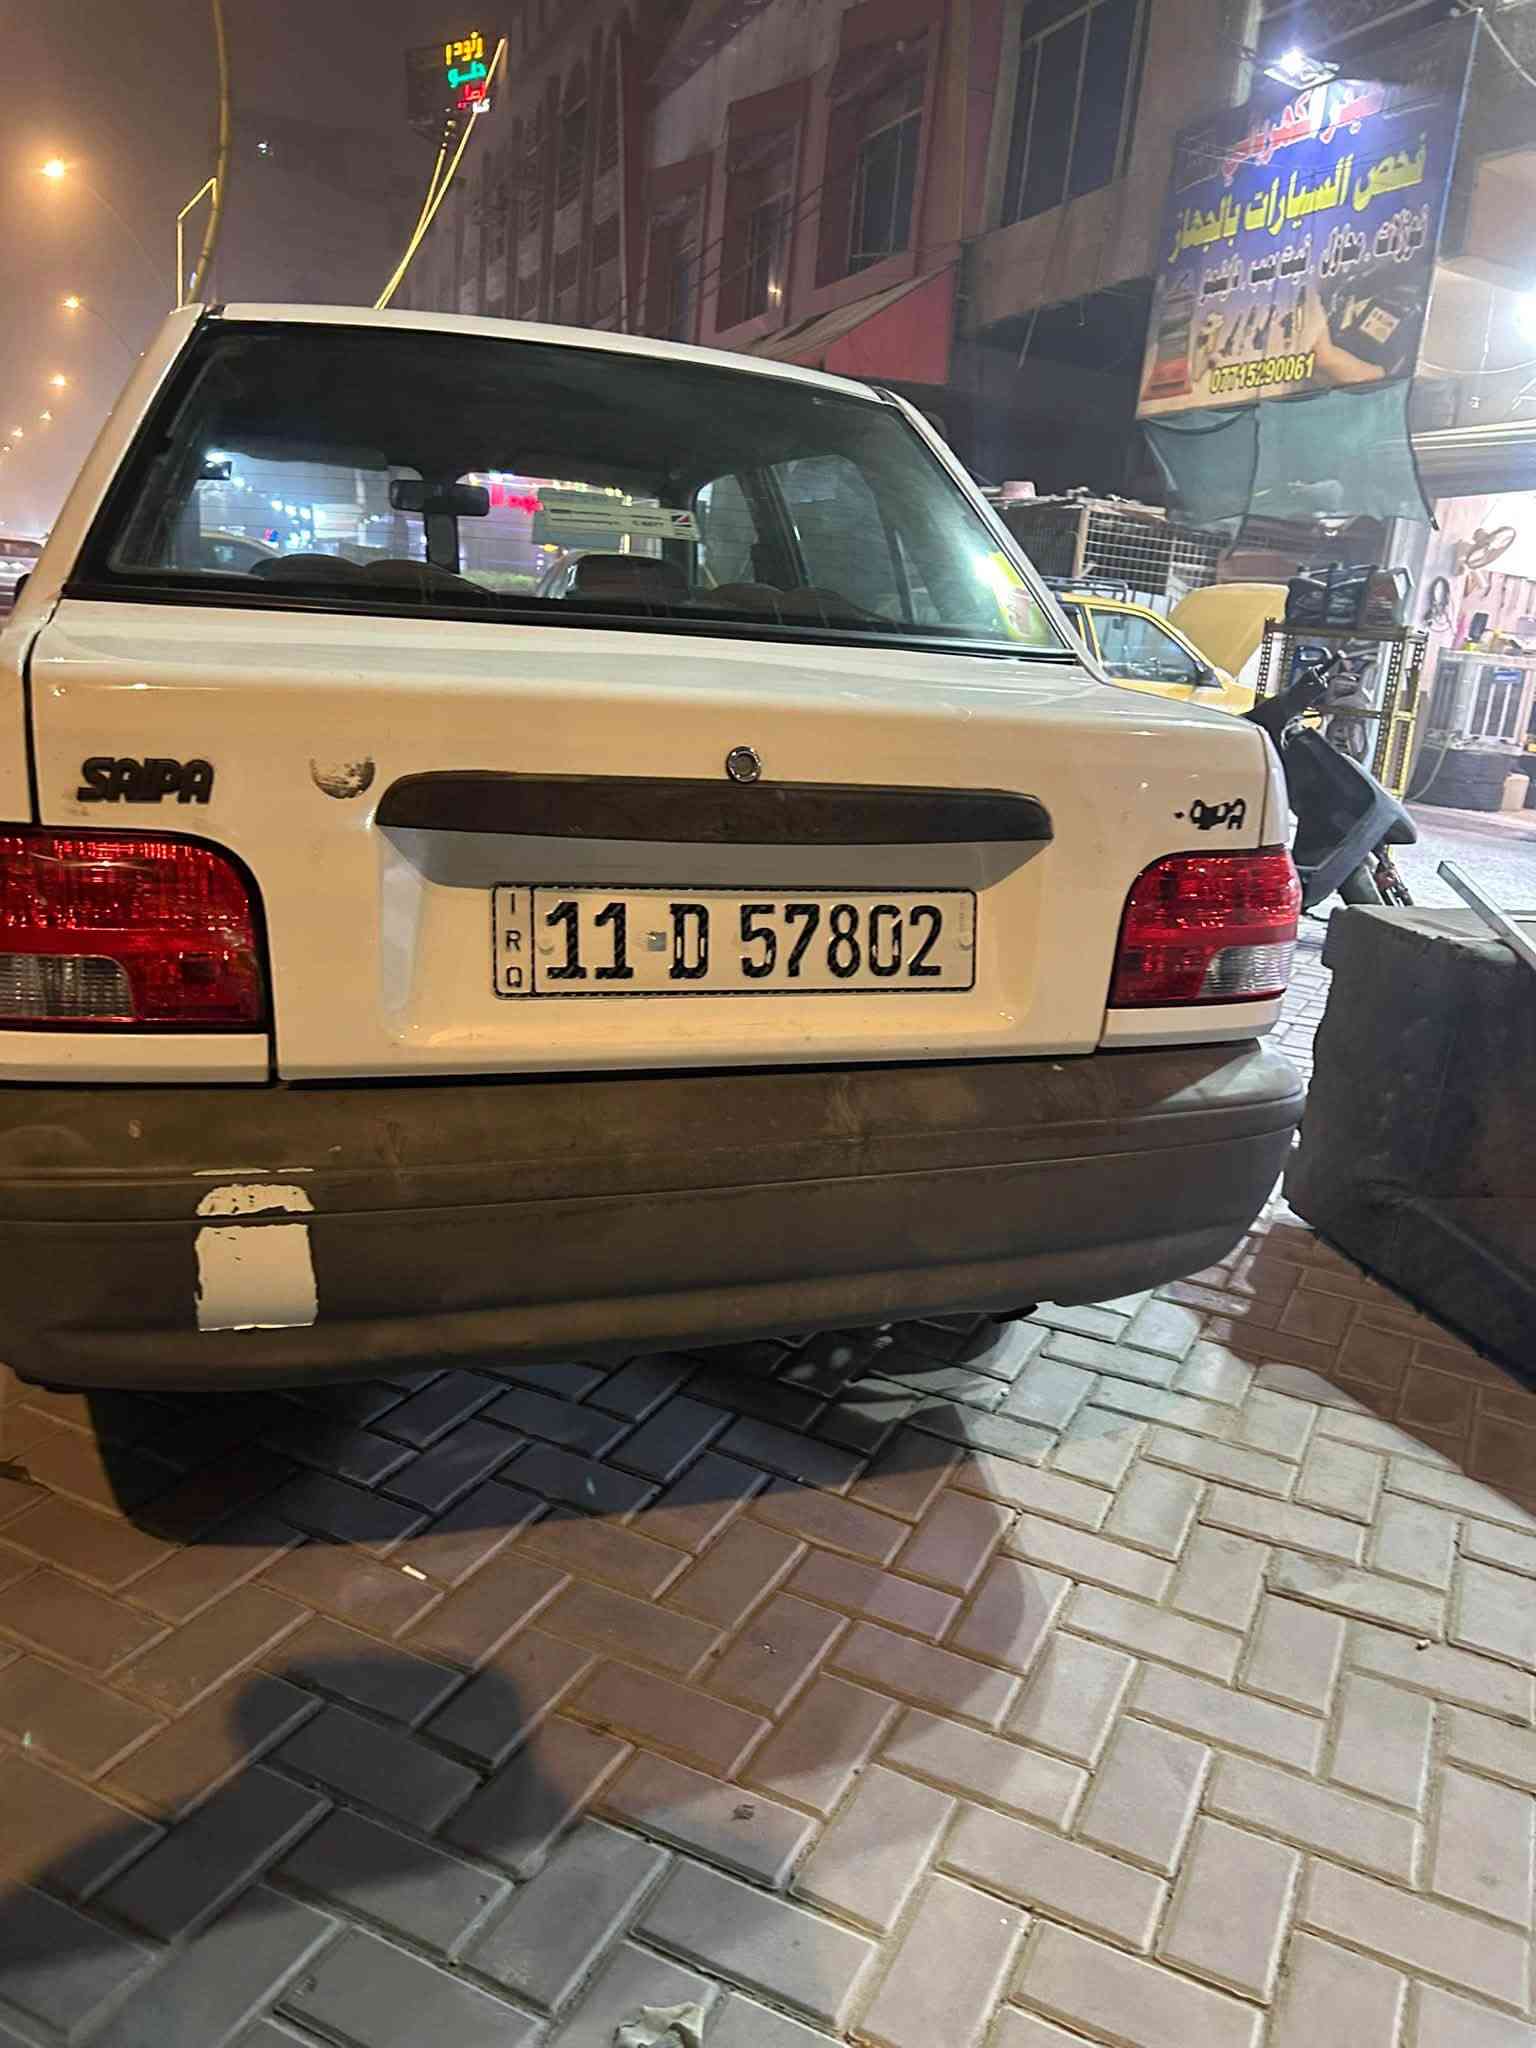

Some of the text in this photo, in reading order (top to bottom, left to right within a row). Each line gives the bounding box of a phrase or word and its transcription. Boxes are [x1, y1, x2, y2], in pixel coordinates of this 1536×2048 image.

[1352, 133, 1427, 212] فحص
[76, 757, 214, 804] SAIPA
[545, 901, 943, 980] 11 D 57802
